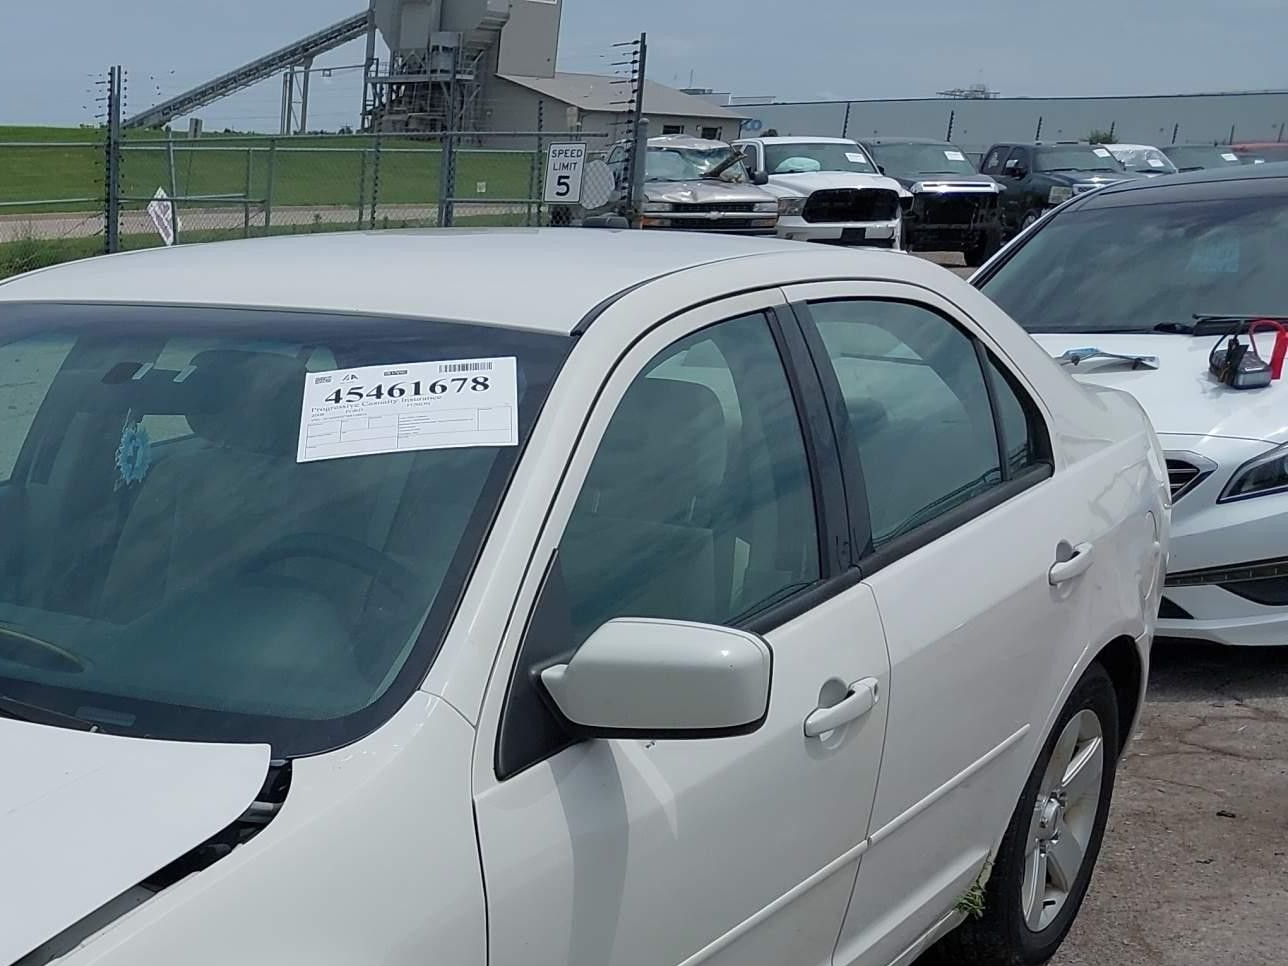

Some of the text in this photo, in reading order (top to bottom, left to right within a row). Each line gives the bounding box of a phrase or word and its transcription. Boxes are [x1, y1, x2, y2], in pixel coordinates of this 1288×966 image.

[551, 149, 583, 158] SPEED
[552, 162, 578, 171] LIMIT
[555, 175, 570, 196] 5
[325, 376, 490, 404] 45461678
